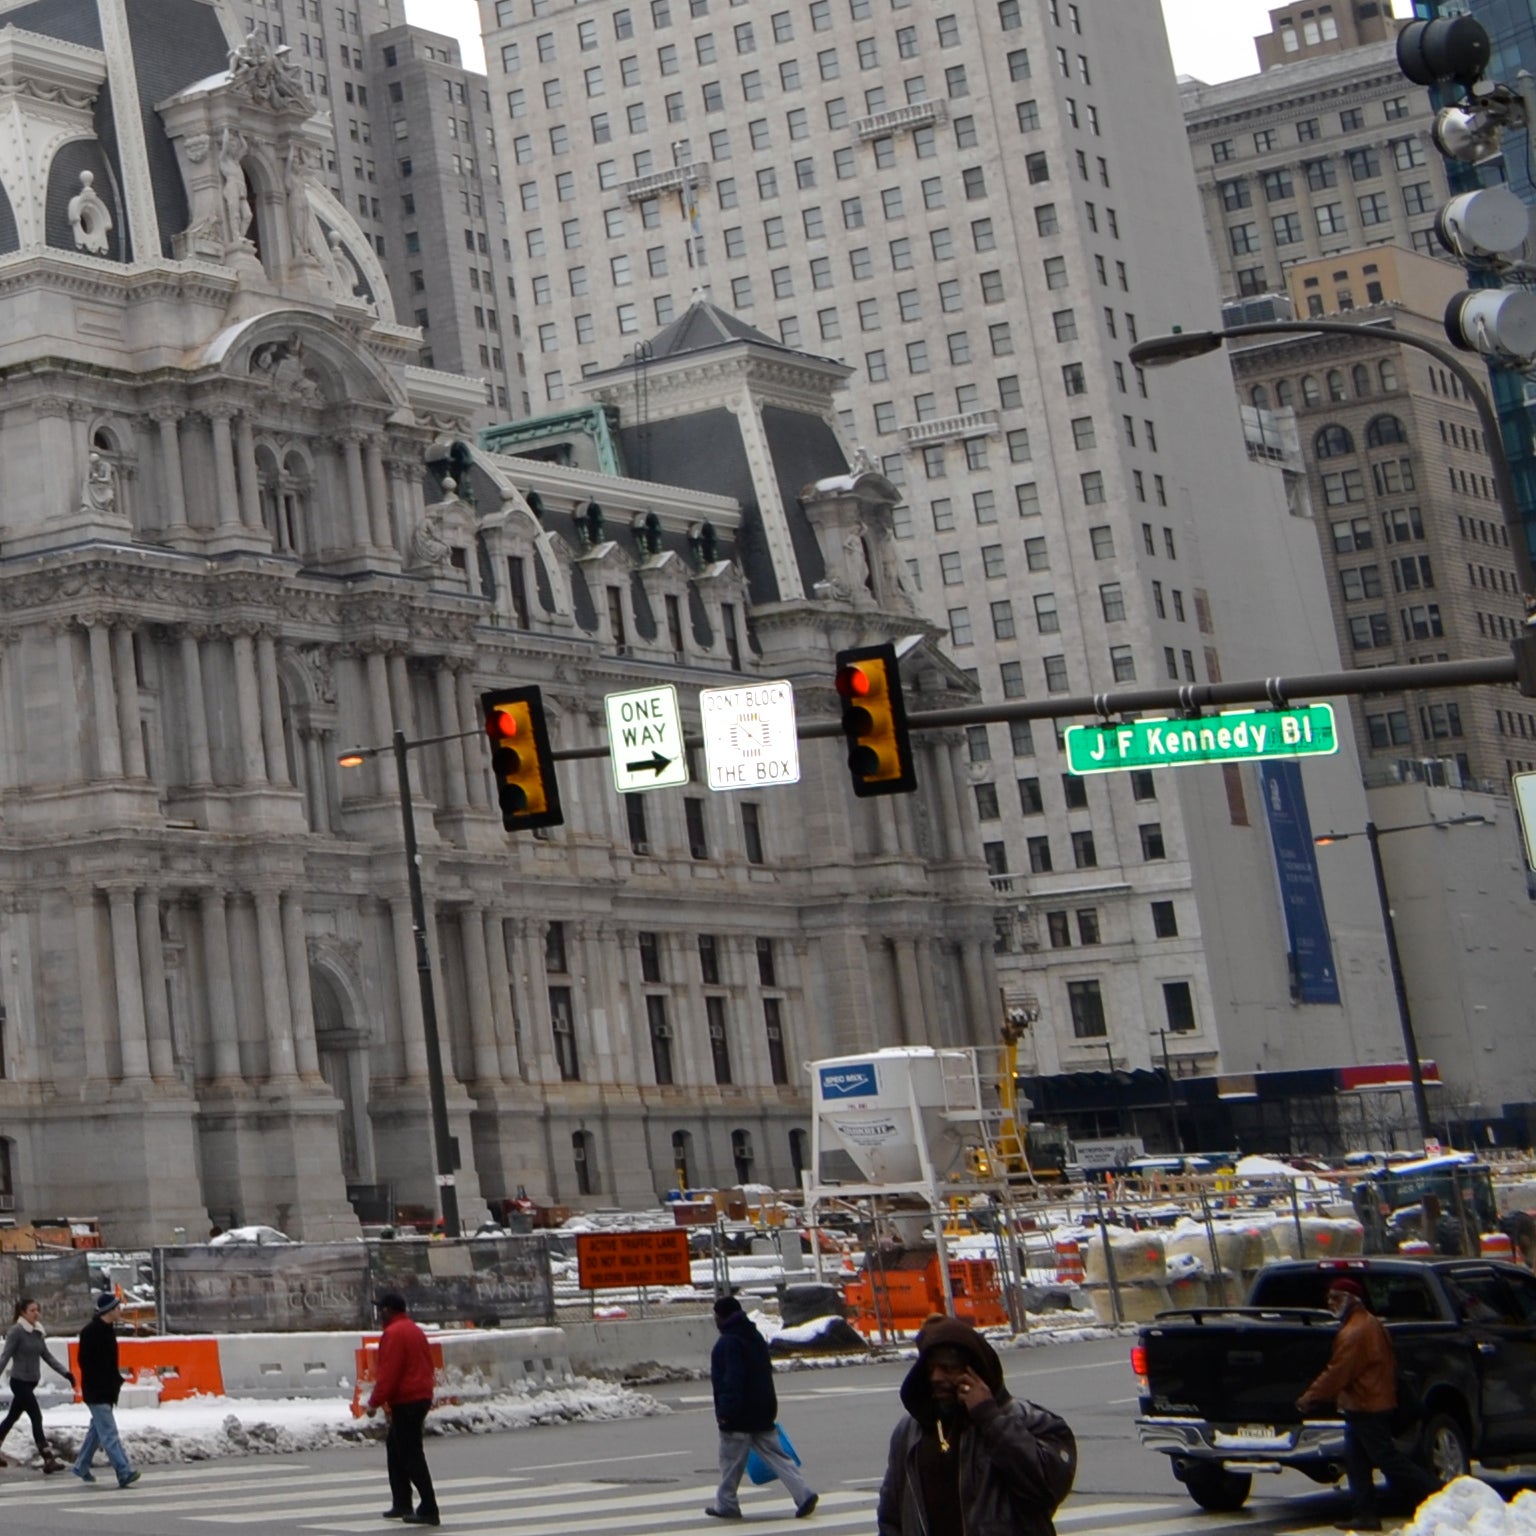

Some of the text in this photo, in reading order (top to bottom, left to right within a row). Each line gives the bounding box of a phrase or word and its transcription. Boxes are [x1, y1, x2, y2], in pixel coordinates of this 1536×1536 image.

[621, 697, 663, 723] ONE
[746, 688, 785, 707] BLOCK
[622, 722, 666, 749] WAY
[1090, 715, 1312, 760] J F Kennedy Bl
[716, 760, 791, 783] THE BOX
